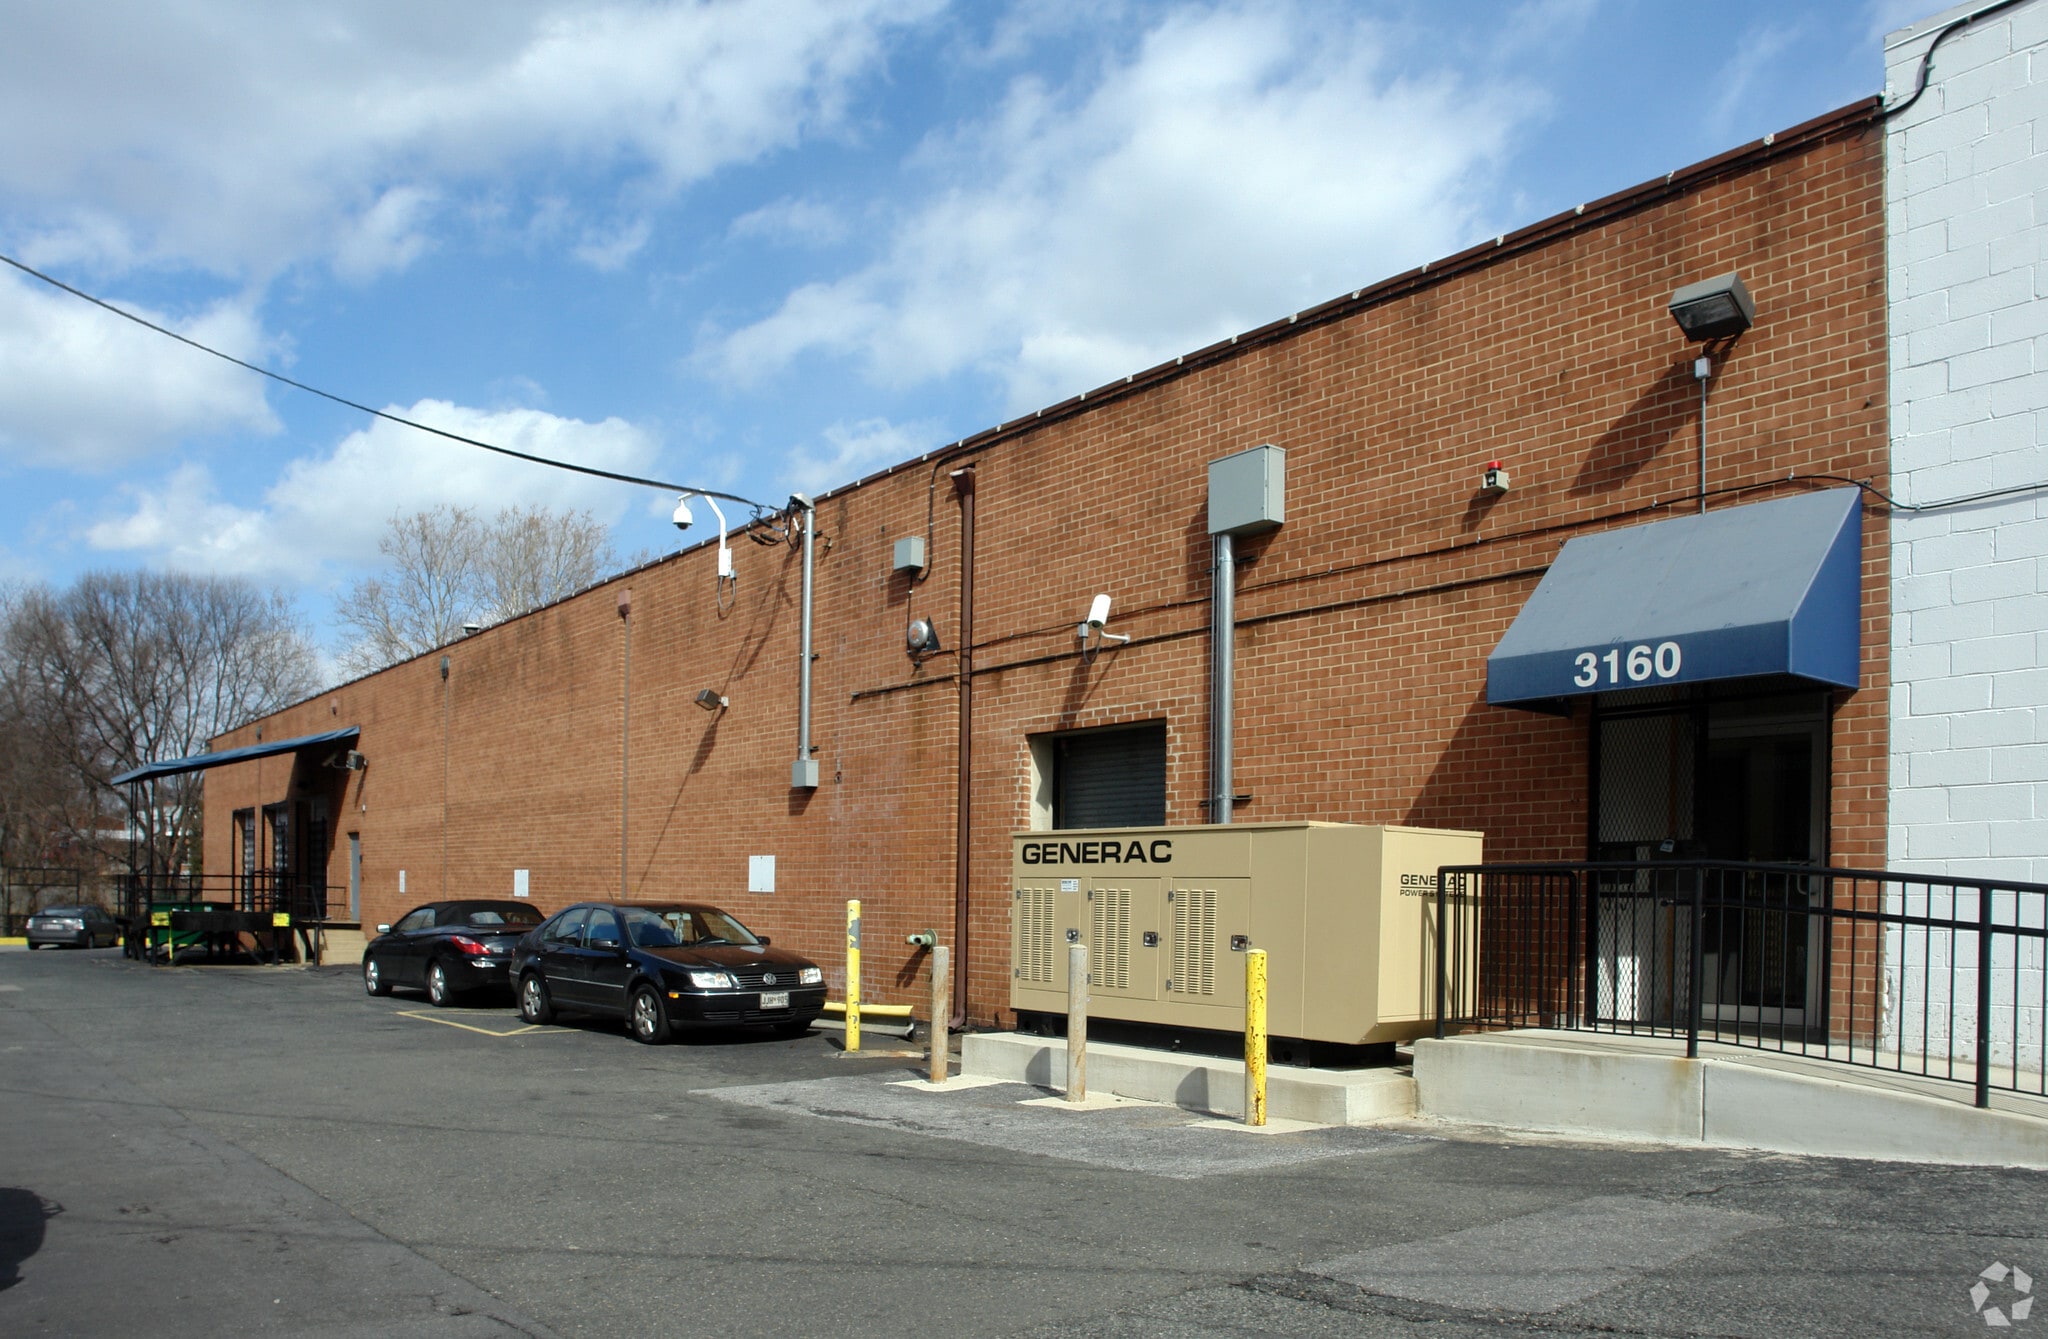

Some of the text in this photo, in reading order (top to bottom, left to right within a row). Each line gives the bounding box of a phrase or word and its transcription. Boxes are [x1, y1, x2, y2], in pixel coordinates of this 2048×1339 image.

[1573, 641, 1682, 688] 3160
[1022, 840, 1172, 864] GENERAC
[1400, 874, 1467, 887] GENEA
